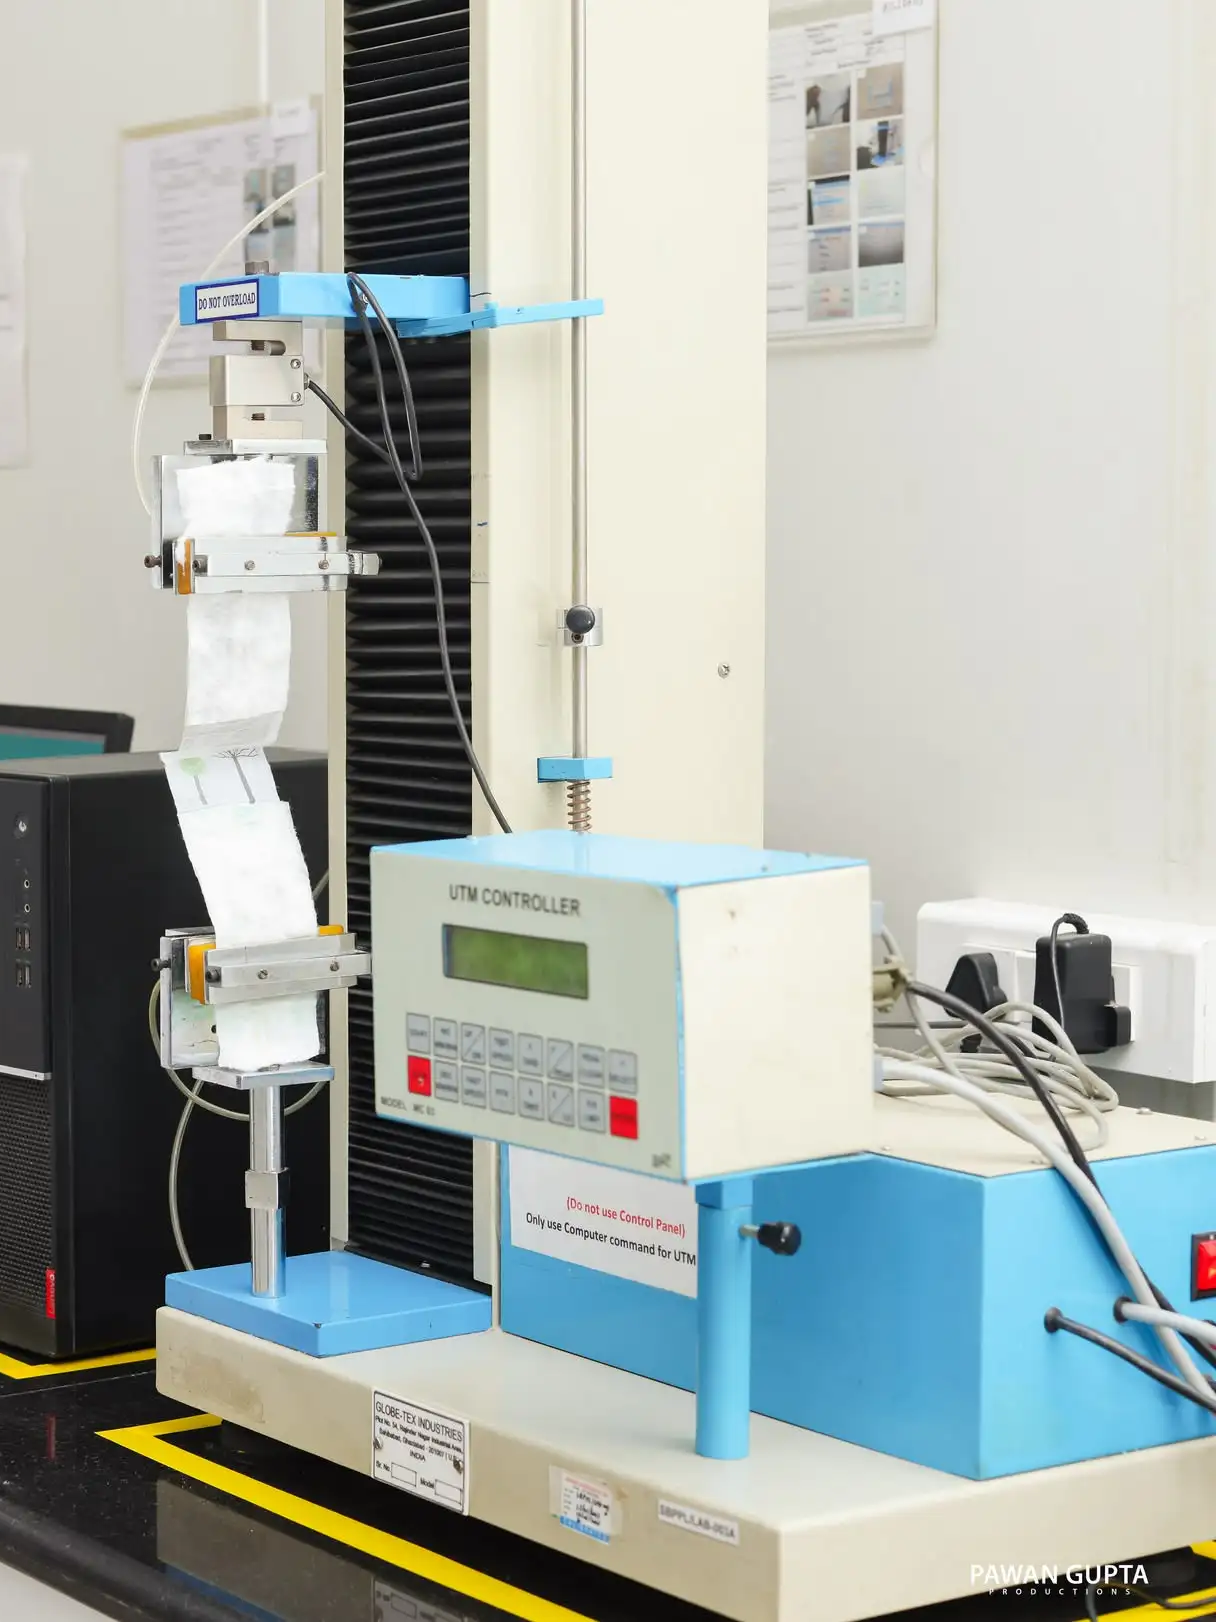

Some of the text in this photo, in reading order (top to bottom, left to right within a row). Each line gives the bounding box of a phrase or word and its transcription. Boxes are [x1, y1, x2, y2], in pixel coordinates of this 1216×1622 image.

[198, 292, 256, 310] DO NOT OVERLOAD
[449, 883, 581, 917] UTM CONTROLLER
[380, 1095, 407, 1111] MODEL
[567, 1196, 686, 1239] (Do not use Control Panel)
[526, 1212, 697, 1266] Only use Computer command for UTM
[375, 1401, 463, 1442] GLOBE-TEX INDUSTRIES
[409, 1450, 426, 1461] INDIA
[420, 1476, 435, 1489] Model
